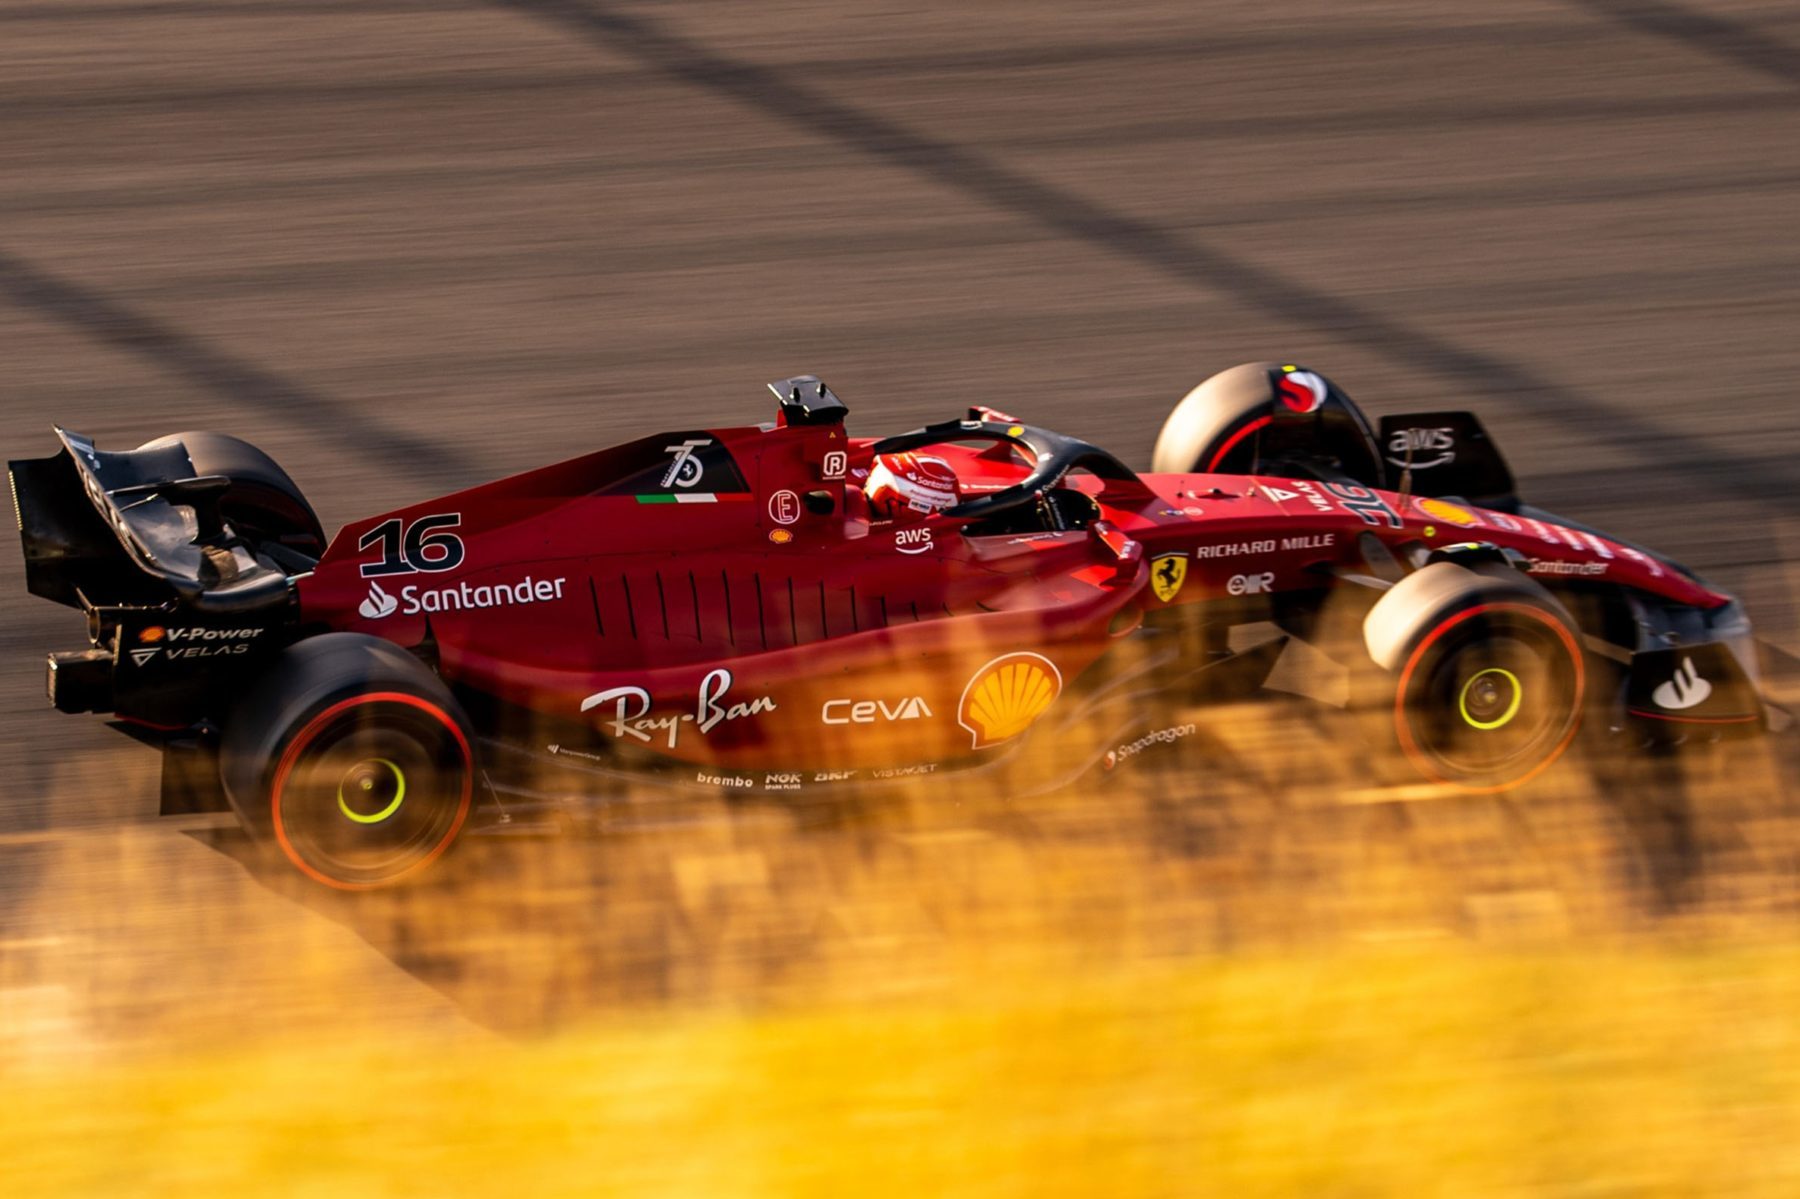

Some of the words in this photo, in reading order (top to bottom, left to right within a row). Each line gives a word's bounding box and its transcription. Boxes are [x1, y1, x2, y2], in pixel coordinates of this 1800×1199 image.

[1389, 427, 1454, 451] aws
[359, 512, 465, 578] 16
[895, 527, 931, 545] aws
[1197, 540, 1276, 559] RICHARD
[1281, 533, 1335, 551] MILLE
[402, 575, 566, 615] Santander
[166, 627, 264, 642] V-Power
[166, 643, 249, 660] VELAS
[580, 668, 777, 749] Ray-Ban
[1117, 723, 1196, 762] Snapdragon
[697, 772, 753, 788] brembo
[765, 774, 803, 784] NGK
